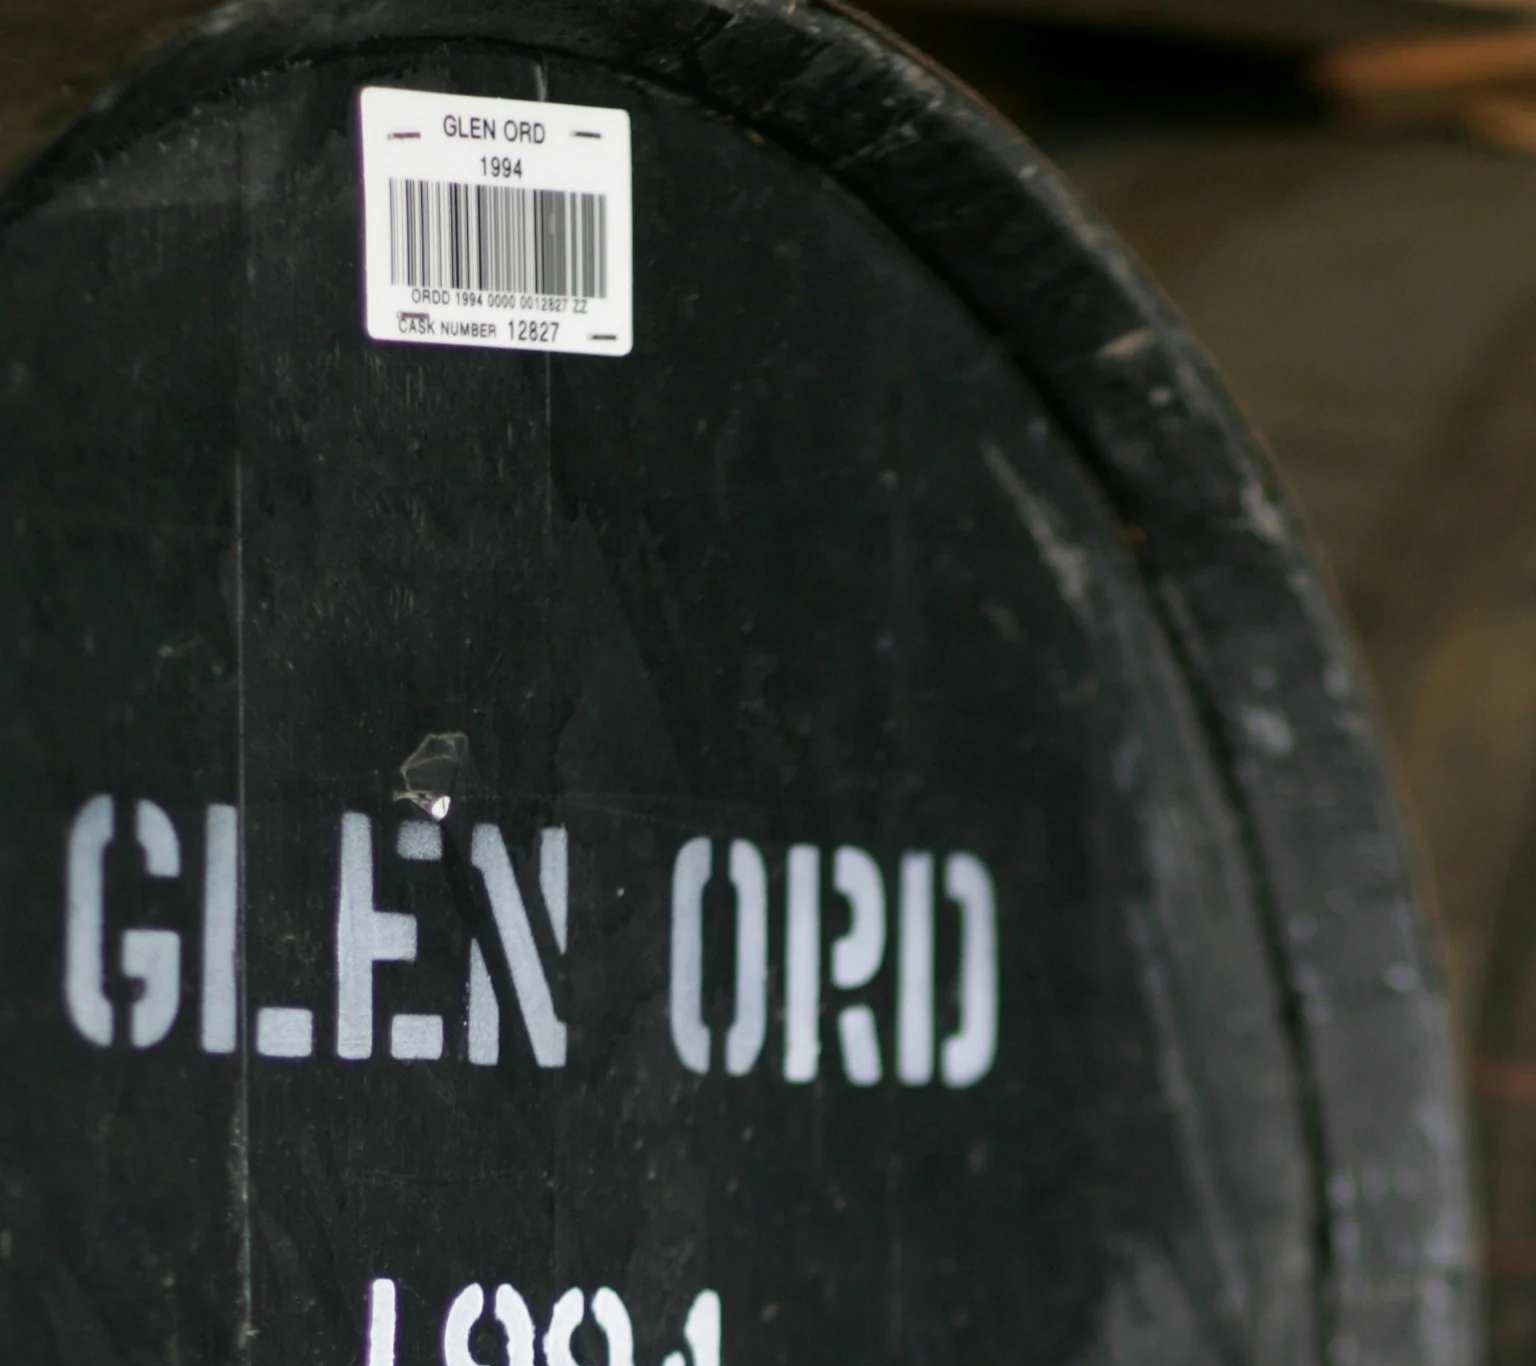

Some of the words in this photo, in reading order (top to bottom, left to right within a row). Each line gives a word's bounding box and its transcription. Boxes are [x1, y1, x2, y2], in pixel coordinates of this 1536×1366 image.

[443, 114, 496, 140] GLEN
[504, 120, 546, 144] ORD
[480, 156, 523, 178] 1994
[411, 289, 450, 305] ORDD
[456, 291, 483, 307] 1994
[487, 294, 515, 309] 0000
[520, 296, 568, 312] 0012827
[573, 299, 588, 313] ZZ
[398, 317, 436, 335] CASK
[440, 320, 497, 338] NUMBER
[508, 321, 560, 342] 12827
[64, 795, 569, 1068] GLEN
[669, 837, 998, 1088] ORD
